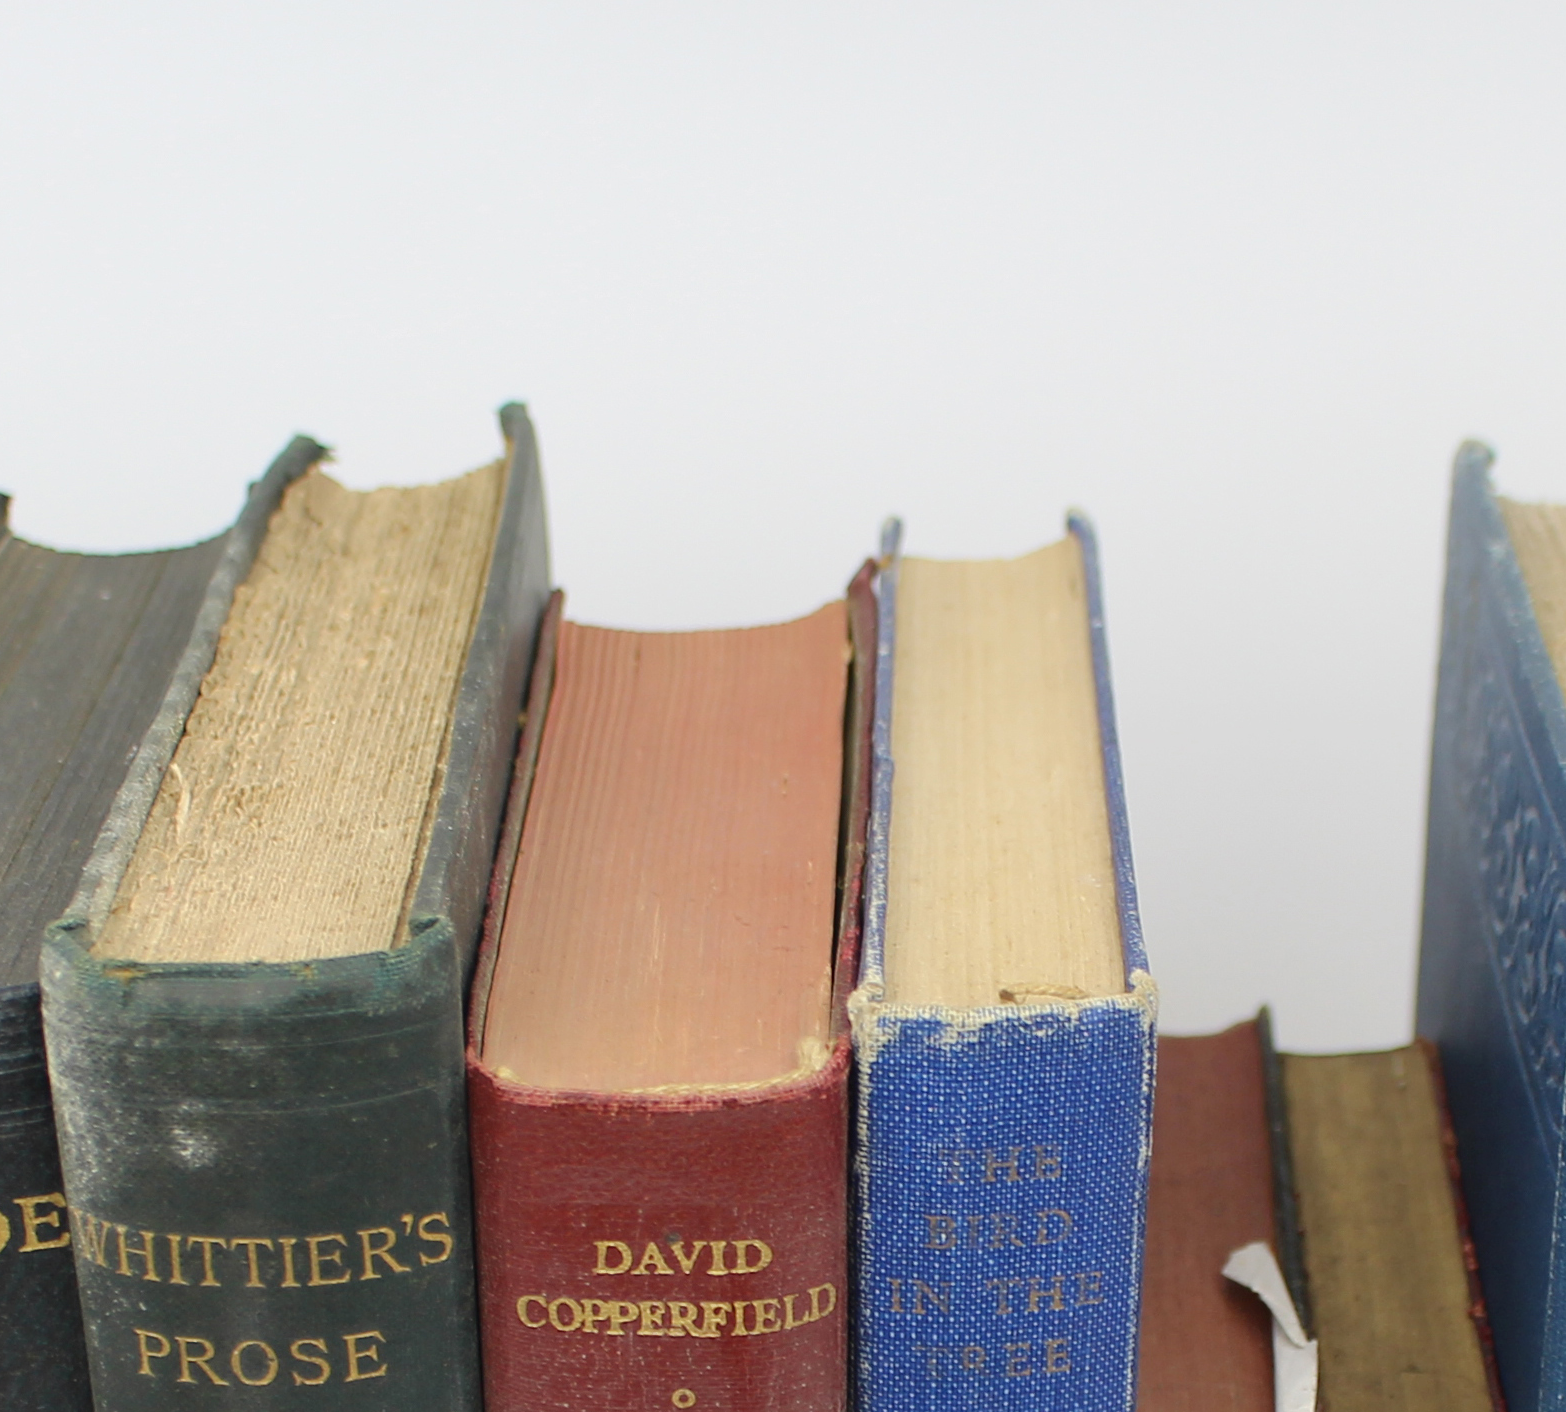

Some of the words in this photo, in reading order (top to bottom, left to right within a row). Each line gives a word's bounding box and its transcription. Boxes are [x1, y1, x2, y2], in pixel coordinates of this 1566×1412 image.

[938, 1144, 1063, 1184] THE
[72, 1211, 454, 1288] WHITTIER'S
[923, 1209, 1073, 1250] BIRD
[592, 1239, 773, 1276] DAVID
[516, 1282, 837, 1338] COPPERFIELD
[887, 1278, 952, 1315] IN
[986, 1271, 1105, 1316] THE
[134, 1330, 388, 1387] PROSE
[913, 1338, 1073, 1378] TREE
